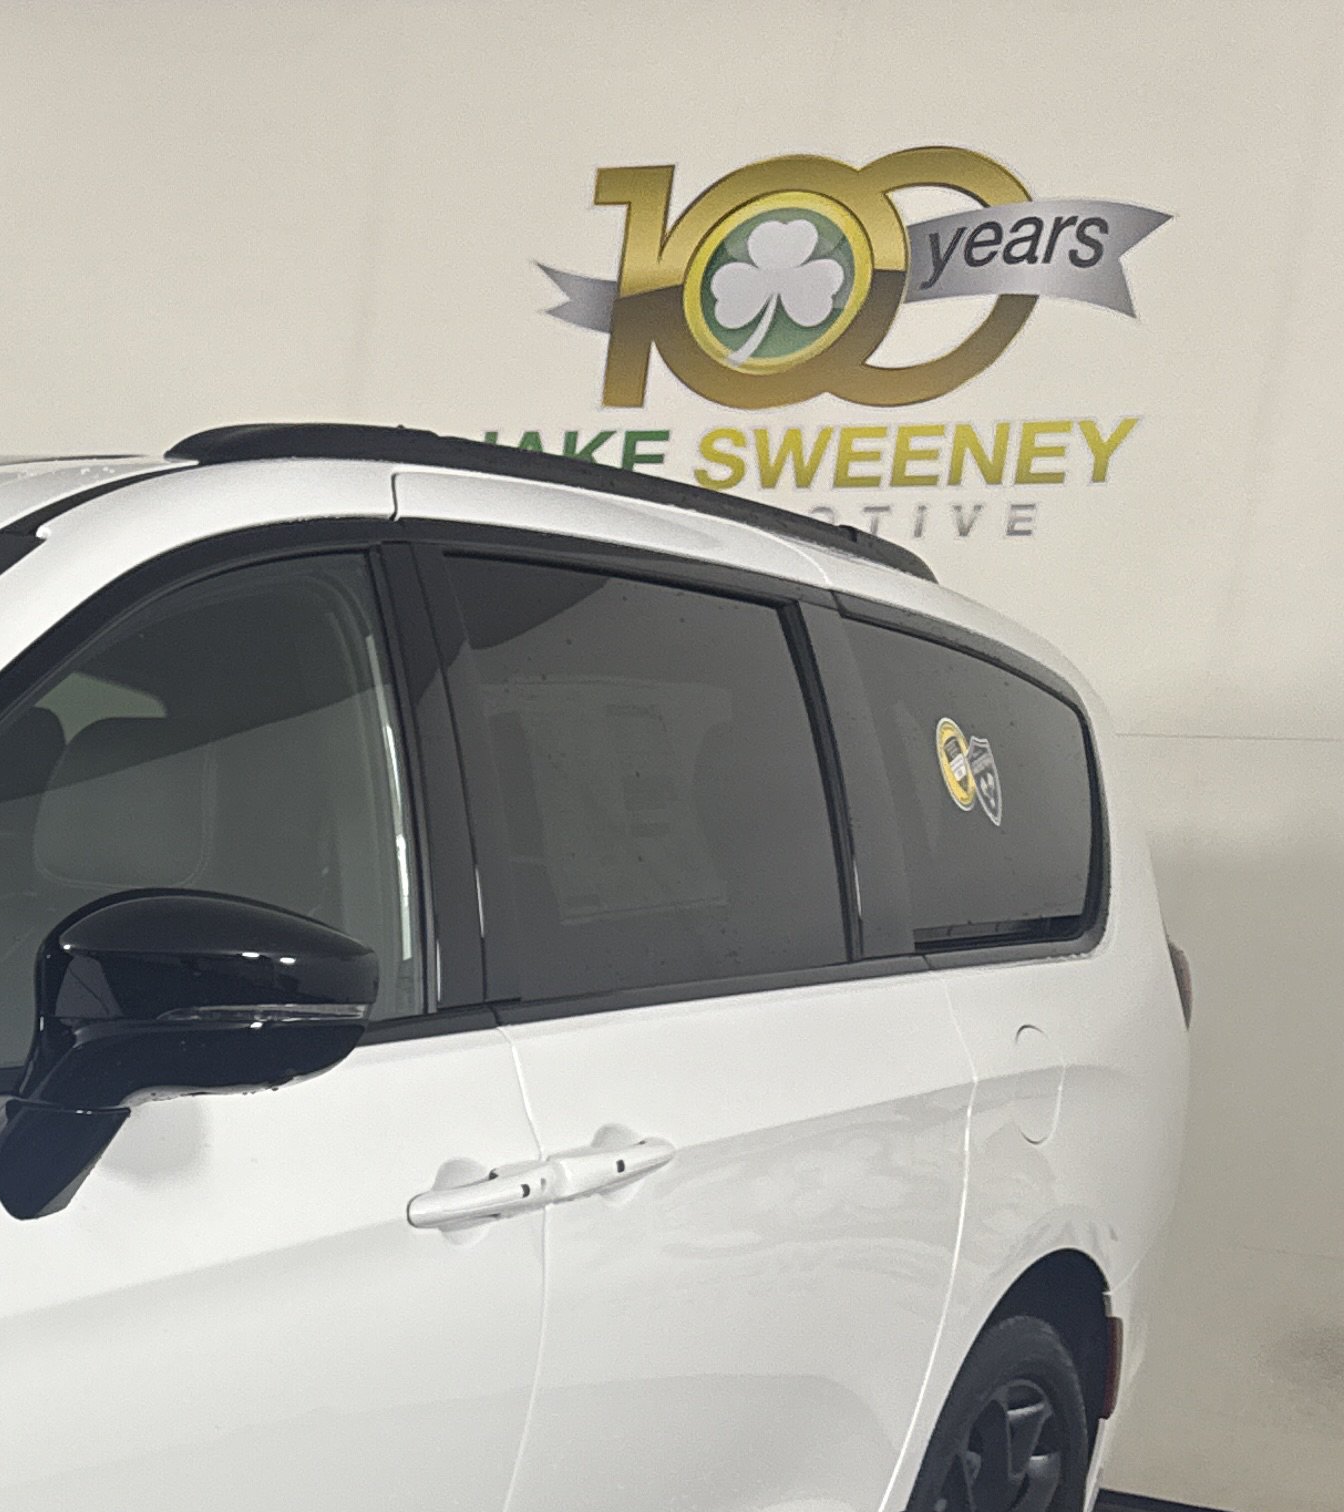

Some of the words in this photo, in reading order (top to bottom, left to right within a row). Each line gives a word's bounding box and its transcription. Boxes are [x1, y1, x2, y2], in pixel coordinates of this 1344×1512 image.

[593, 145, 1040, 410] 100
[919, 214, 1109, 290] years
[693, 417, 1140, 490] SWEENEY
